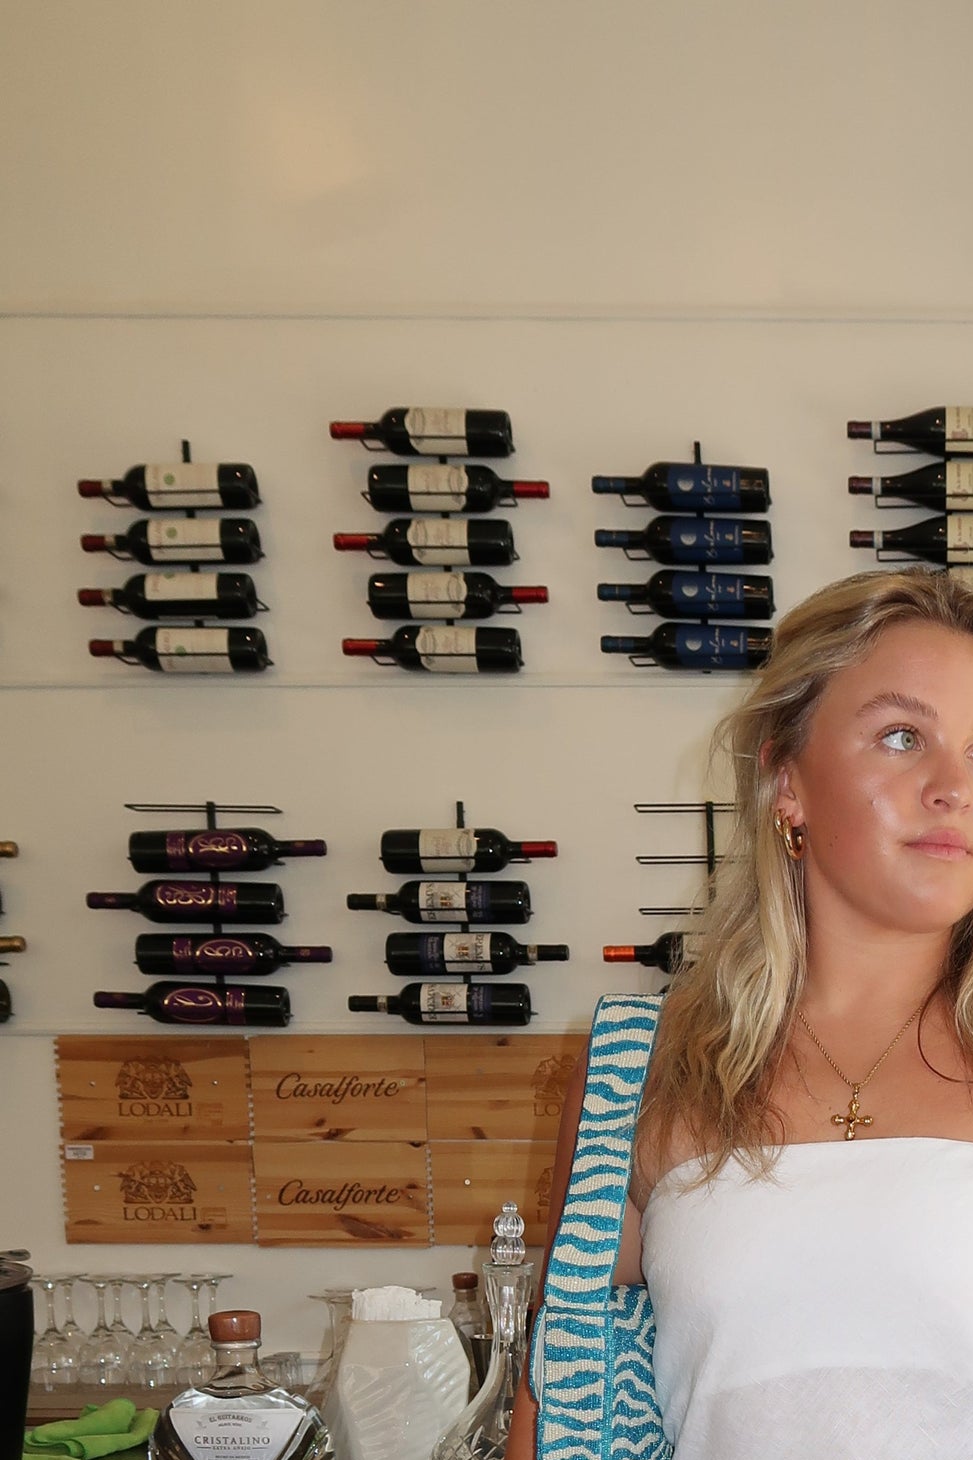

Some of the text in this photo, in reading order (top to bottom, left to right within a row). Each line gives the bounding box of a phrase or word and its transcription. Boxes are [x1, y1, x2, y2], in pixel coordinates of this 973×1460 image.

[276, 1072, 400, 1105] Casalforte
[118, 1102, 193, 1117] LODALI
[533, 1102, 561, 1117] LO
[278, 1179, 401, 1211] Casalforte
[122, 1206, 197, 1221] LODALI
[194, 1435, 271, 1445] CRISTALINO
